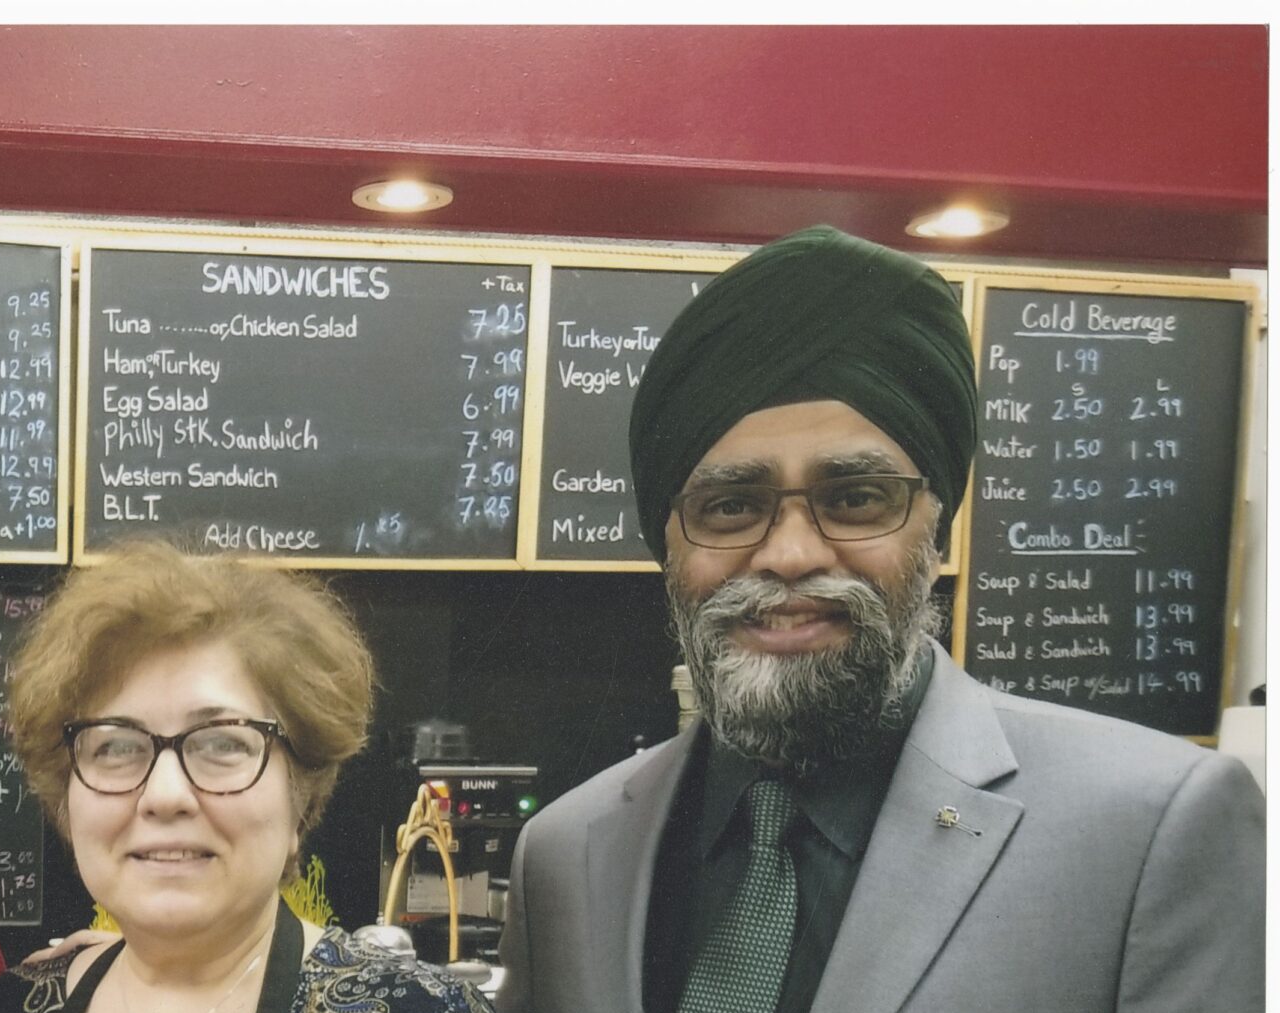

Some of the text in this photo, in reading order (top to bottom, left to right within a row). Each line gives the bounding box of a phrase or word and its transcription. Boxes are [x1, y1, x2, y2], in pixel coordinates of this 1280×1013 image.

[202, 262, 390, 300] SANDWICHES
[7, 291, 50, 316] 9.25
[102, 303, 525, 339] Tuna Chicken Salad 7.25
[1022, 301, 1176, 344] Cold Beverage
[8, 322, 52, 352] 9.25
[557, 321, 623, 357] Turkey
[0, 353, 52, 381] 12.99
[156, 349, 221, 383] Turkey
[461, 348, 523, 380] 7.99
[558, 360, 621, 394] Veggie
[989, 344, 1099, 383] Pop 1.99
[1072, 378, 1169, 396] S L
[104, 385, 519, 420] Egg Salad 6.99
[1051, 396, 1182, 421] 2.50 2.99
[220, 417, 514, 458] Sandwich 7.99
[983, 435, 1177, 460] Water 1.50 1.99
[0, 454, 53, 478] 12.99
[100, 461, 515, 489] Western Sandwich 7.50
[552, 469, 625, 493] Garden
[982, 476, 1177, 501] Juice 2.50 2.99
[8, 485, 51, 512] 7.50
[458, 496, 512, 524] 7.25
[205, 523, 320, 552] Add Cheese
[553, 511, 623, 543] Mixed
[1008, 521, 1131, 550] Combo Deal
[977, 568, 1194, 596] Soup Salad 11.99
[976, 603, 1194, 637] Soup Sandwich 13.99
[977, 635, 1195, 661] Salad Sandwich 13.99
[461, 779, 497, 791] BUNN
